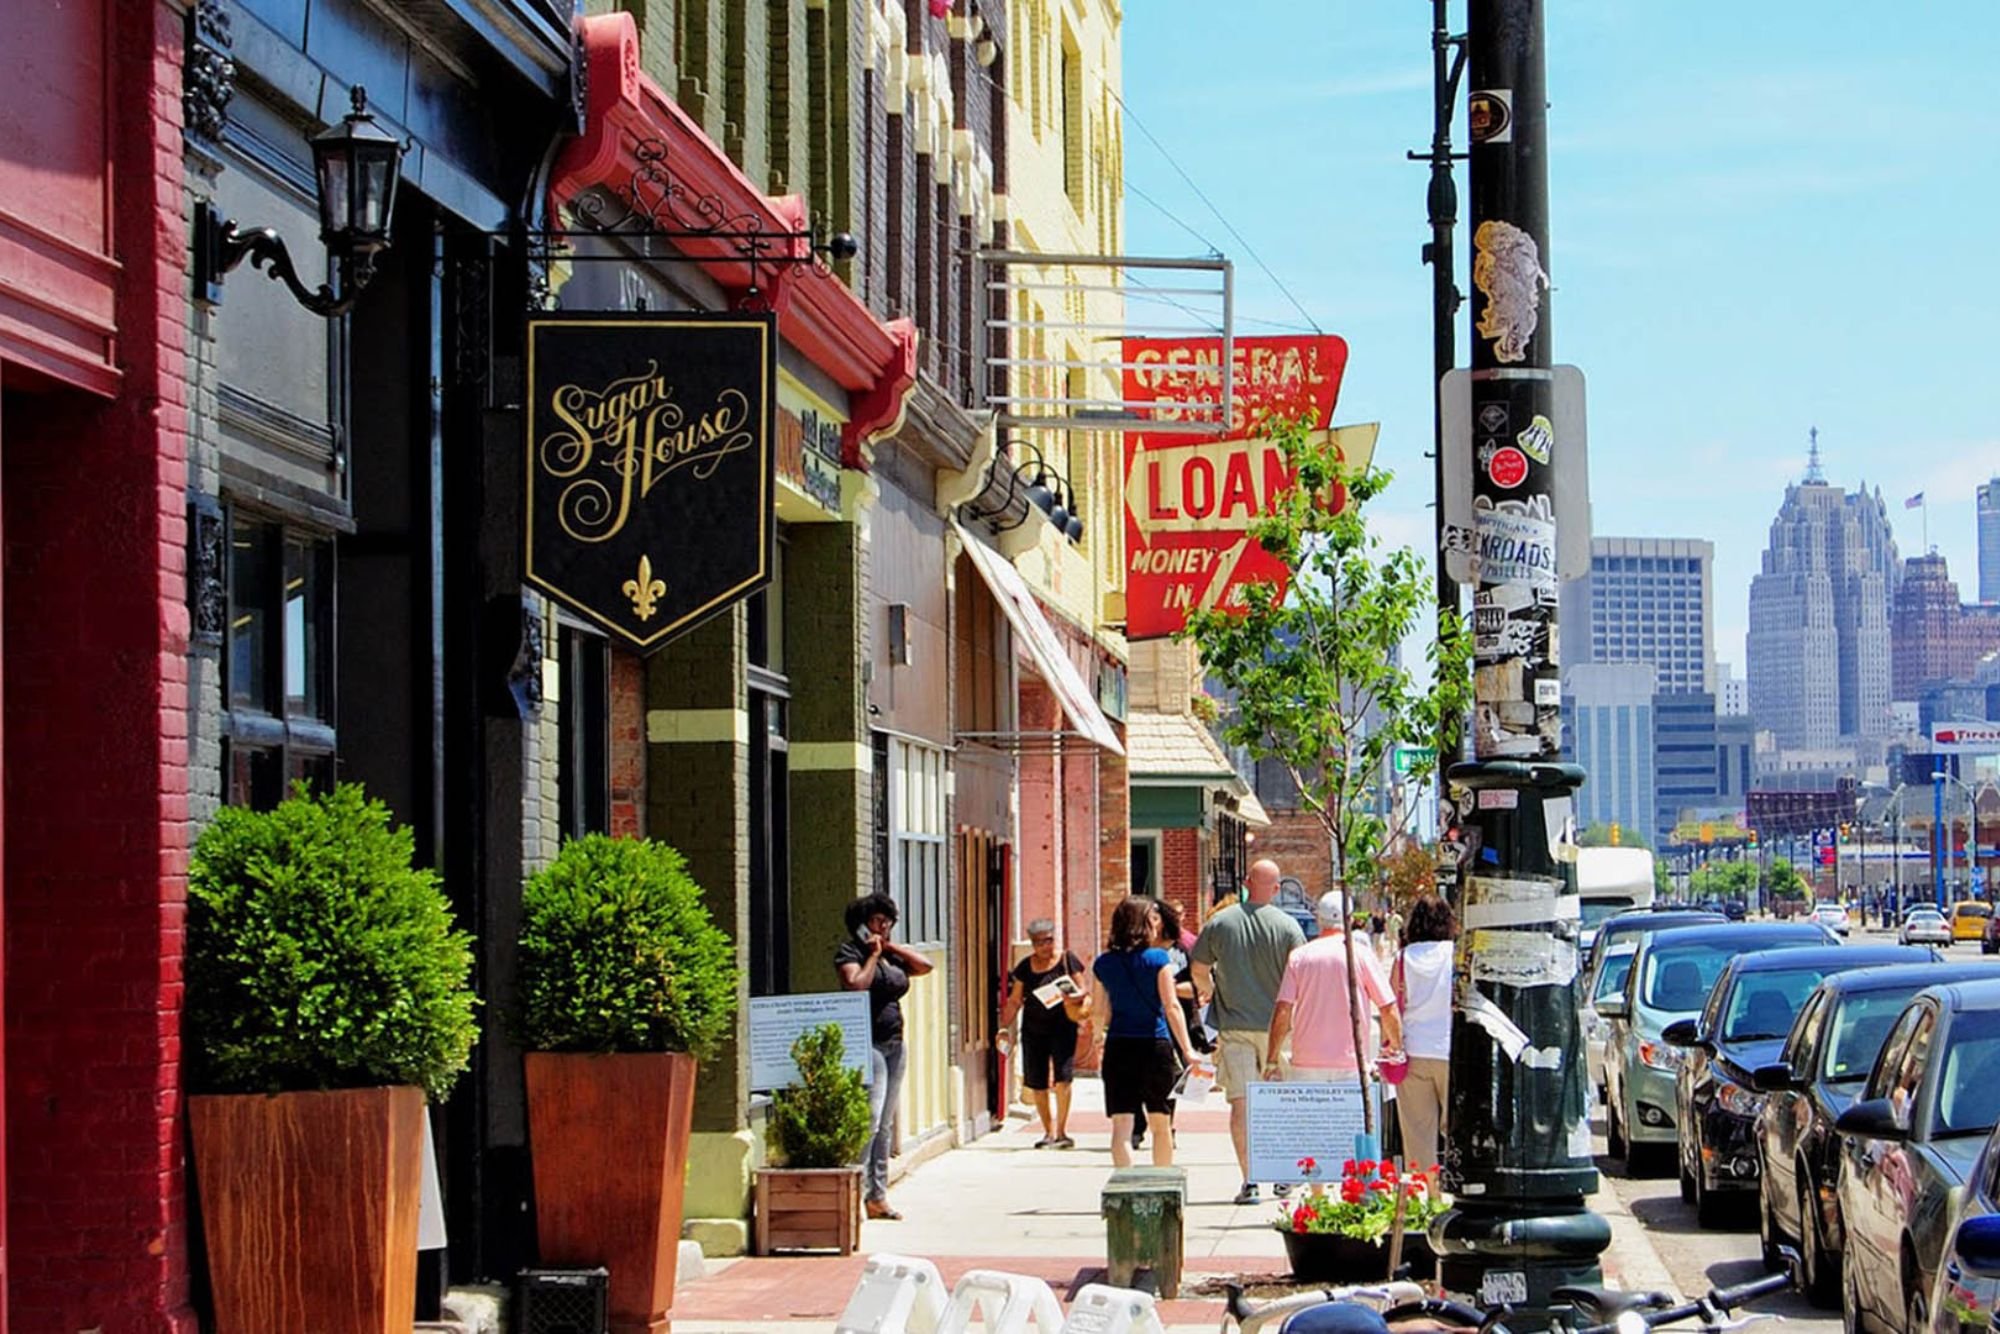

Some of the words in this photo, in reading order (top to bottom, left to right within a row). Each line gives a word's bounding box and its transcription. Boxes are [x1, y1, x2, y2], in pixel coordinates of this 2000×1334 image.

[1134, 347, 1327, 388] GENERAL
[541, 359, 672, 477] Sugar
[558, 388, 752, 543] House
[1131, 548, 1216, 574] MONEY
[1163, 583, 1194, 609] IN
